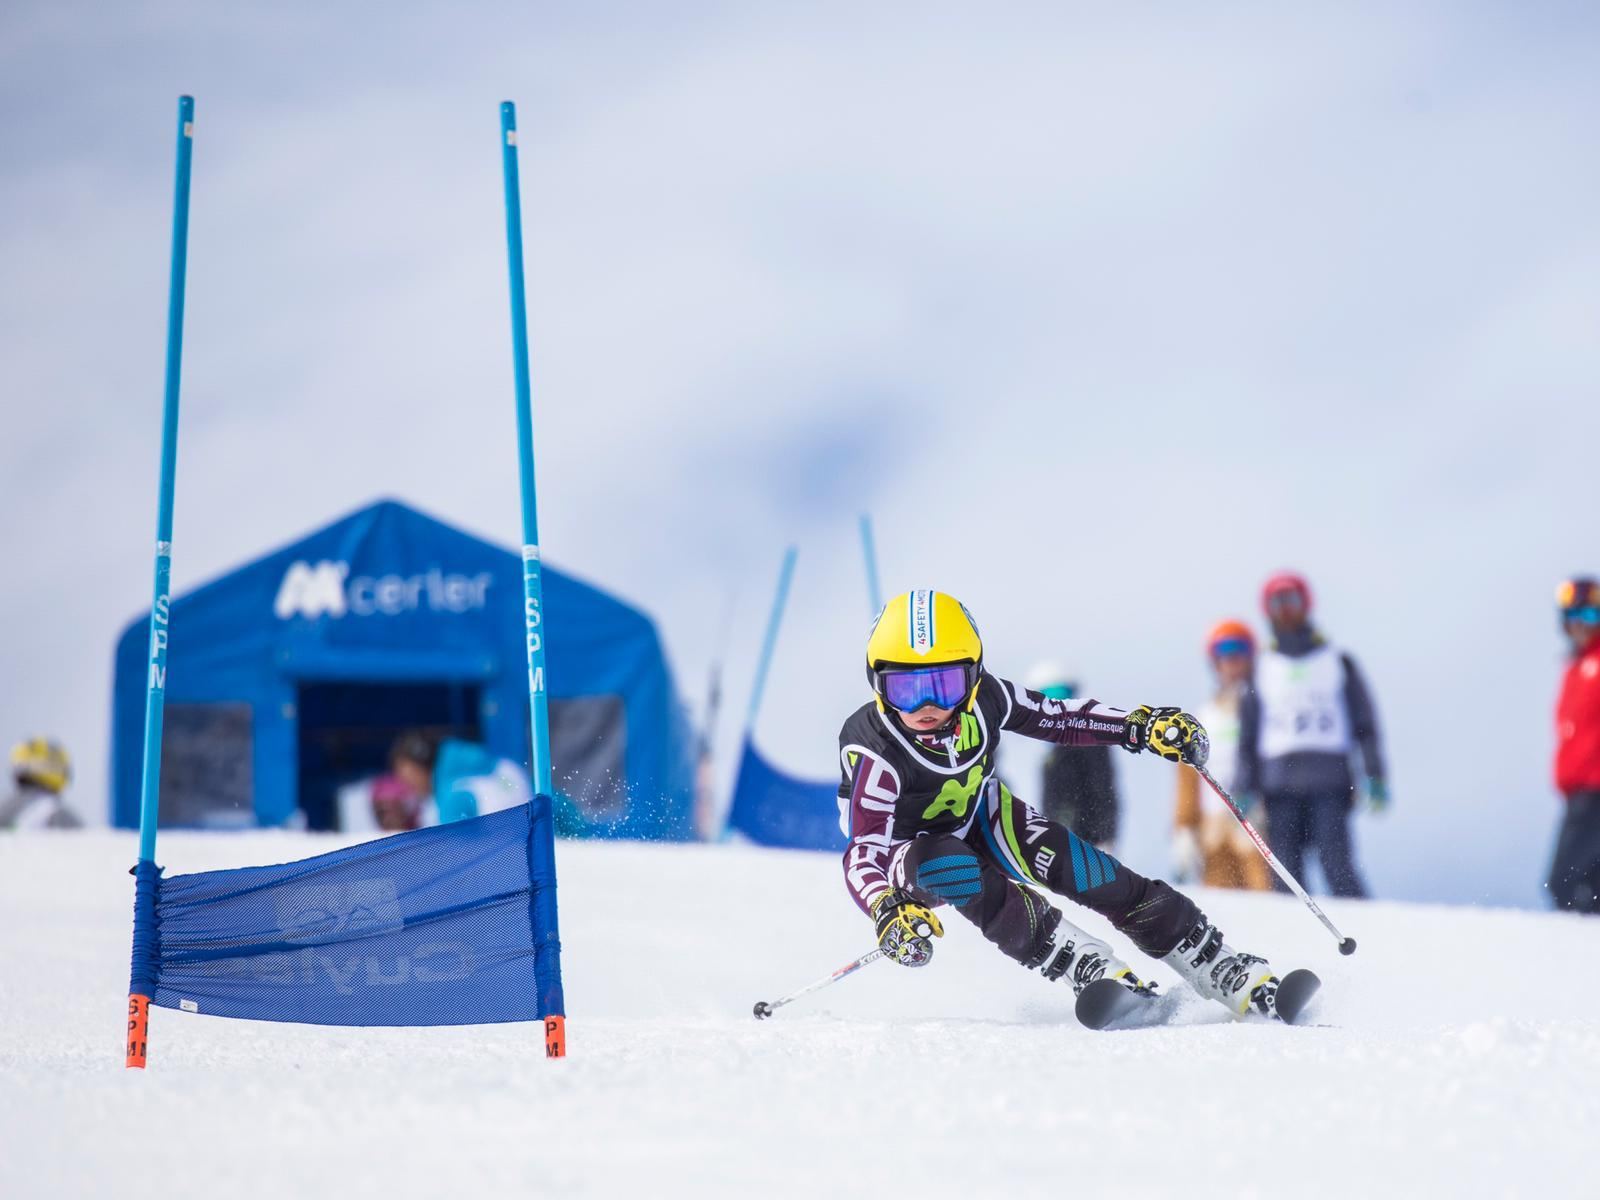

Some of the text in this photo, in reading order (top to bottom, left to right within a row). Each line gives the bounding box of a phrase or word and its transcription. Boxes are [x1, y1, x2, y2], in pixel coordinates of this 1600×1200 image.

[350, 567, 493, 616] cerler
[525, 597, 544, 693] SPM
[1088, 719, 1125, 734] Benasque
